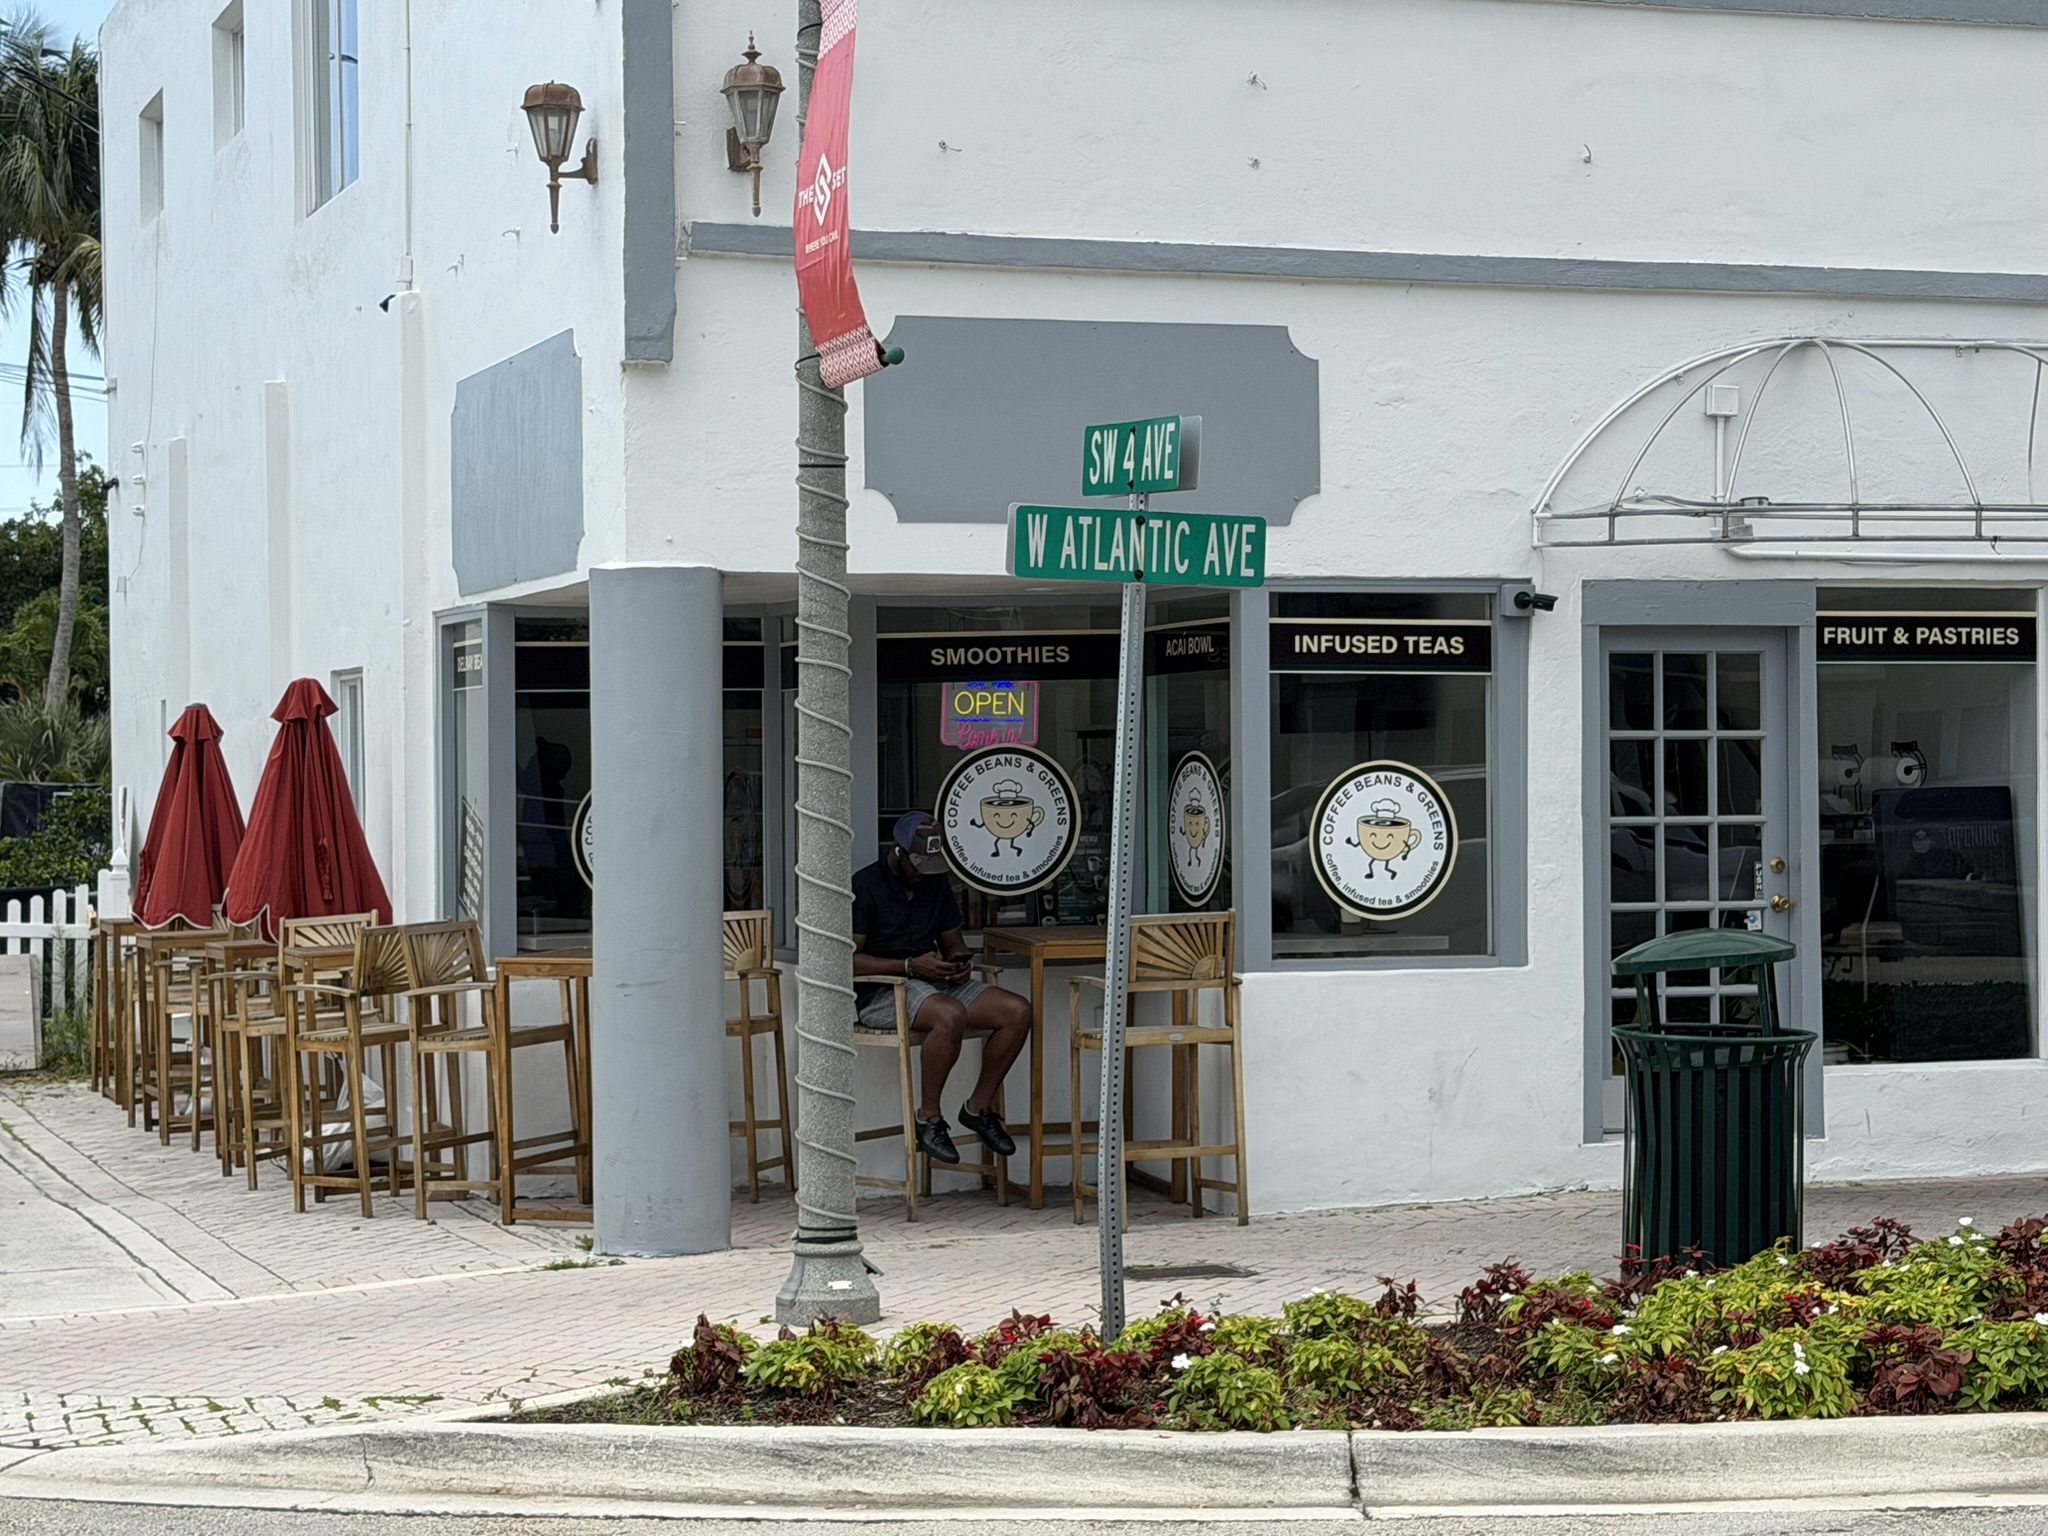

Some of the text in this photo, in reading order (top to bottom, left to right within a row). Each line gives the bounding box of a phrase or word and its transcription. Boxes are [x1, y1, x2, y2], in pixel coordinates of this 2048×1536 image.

[799, 166, 846, 208] THE SET
[1089, 422, 1176, 485] SW 4 AVE
[1027, 514, 1256, 577] W ATLANTIC AVE
[931, 646, 1070, 665] SMOOTHIES
[1188, 635, 1214, 654] BOWL
[1294, 635, 1464, 655] INFUSED TEAS
[1823, 627, 2019, 645] FRUIT & PASTRIES
[954, 691, 1024, 715] OPEN
[947, 756, 1068, 829] COFFEE BEANS & GREENS
[1171, 778, 1183, 835] COFFEE
[1181, 763, 1202, 781] BEANS
[1207, 780, 1220, 838] GREENS
[1323, 774, 1444, 851] COFFEE BEANS & GREENS
[969, 862, 1003, 882] infused
[1006, 873, 1020, 882] tea
[1022, 870, 1030, 879] &
[1031, 835, 1063, 876] smoothies
[1755, 863, 1763, 891] PUSH
[1342, 882, 1375, 905] infused
[1378, 898, 1392, 906] tea
[1395, 895, 1402, 904] &
[1405, 860, 1439, 900] smoothies
